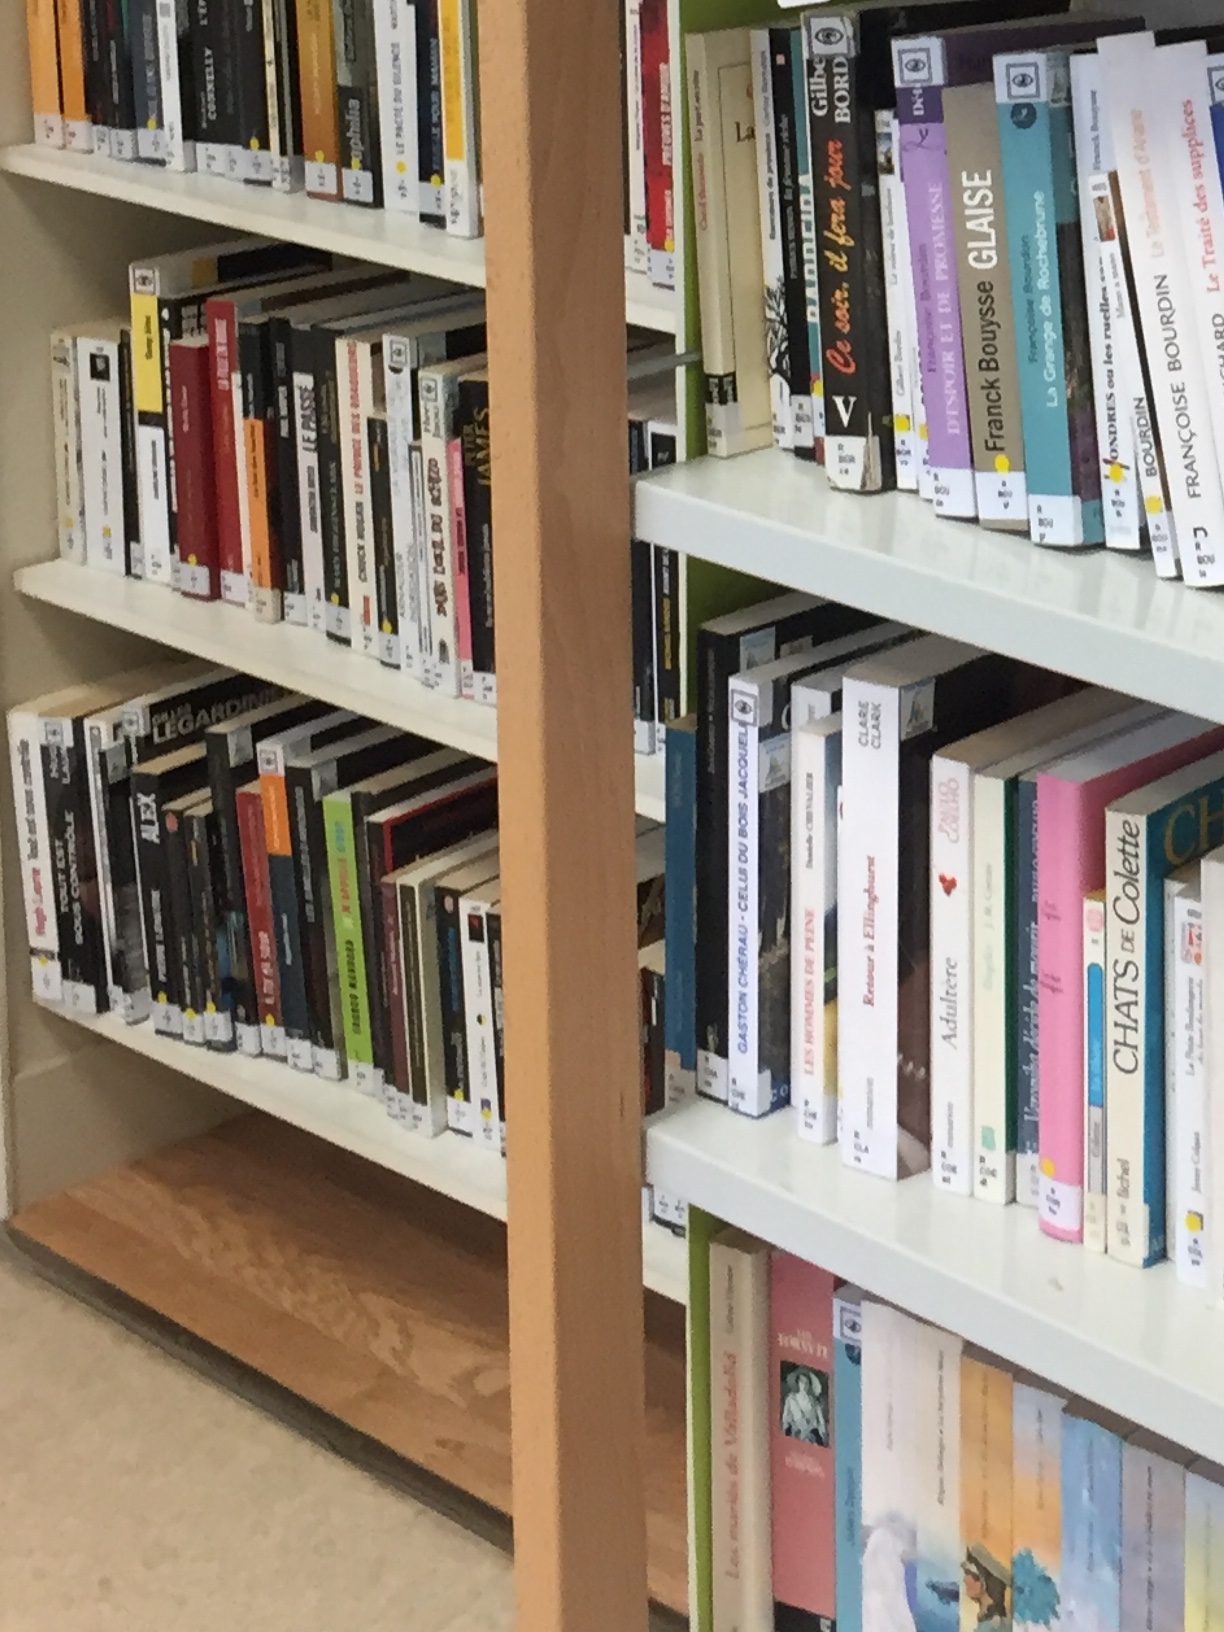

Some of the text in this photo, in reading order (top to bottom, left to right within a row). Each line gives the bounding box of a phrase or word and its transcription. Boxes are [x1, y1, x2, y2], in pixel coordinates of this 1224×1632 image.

[809, 57, 827, 117] Gilbe
[832, 57, 850, 124] BORD
[822, 139, 856, 375] Ce soir, il fera jour
[961, 169, 1005, 452] Franck Bouysse GLAISE
[1153, 273, 1204, 499] FRANÇOISE BOURDIN
[857, 700, 870, 748] CLARE
[870, 702, 882, 750] CLARK
[137, 792, 160, 843] ALEX
[1111, 819, 1141, 1075] CHATS DE Colette
[938, 957, 959, 1050] Adultère
